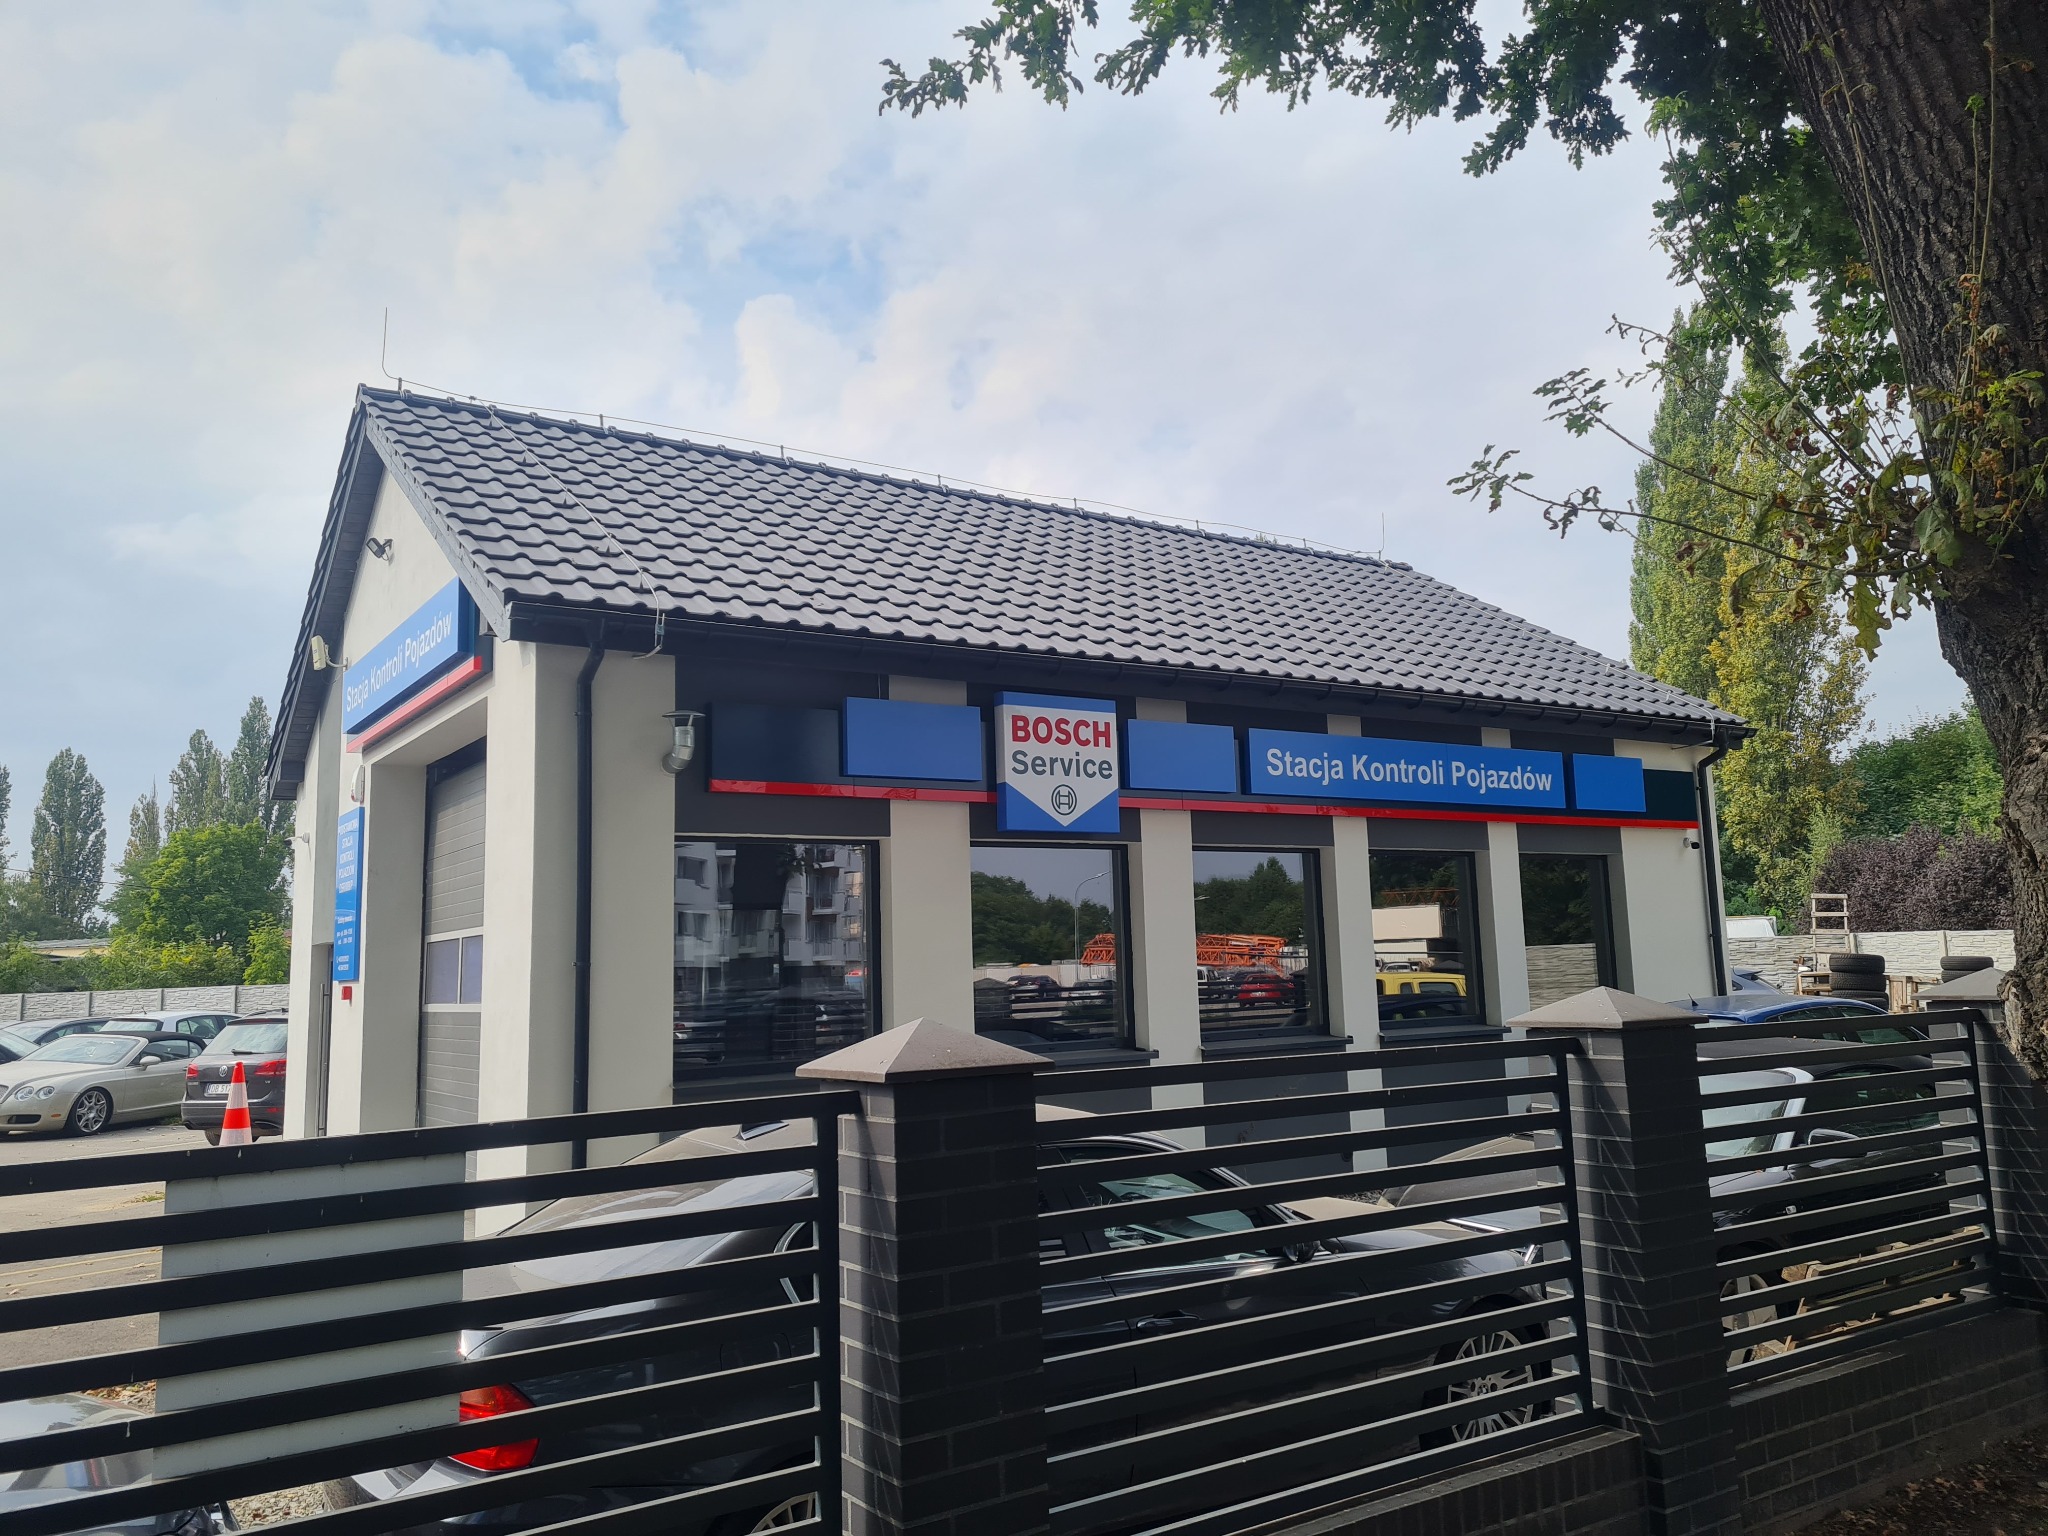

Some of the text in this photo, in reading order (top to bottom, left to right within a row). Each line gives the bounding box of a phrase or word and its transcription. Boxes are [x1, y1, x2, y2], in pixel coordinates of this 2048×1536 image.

[346, 610, 452, 712] Stacja Kontroli Pojazdów
[1011, 714, 1111, 748] BOSCH
[1011, 749, 1113, 779] Service
[1266, 748, 1552, 794] Stacja Kontroli Pojazdów
